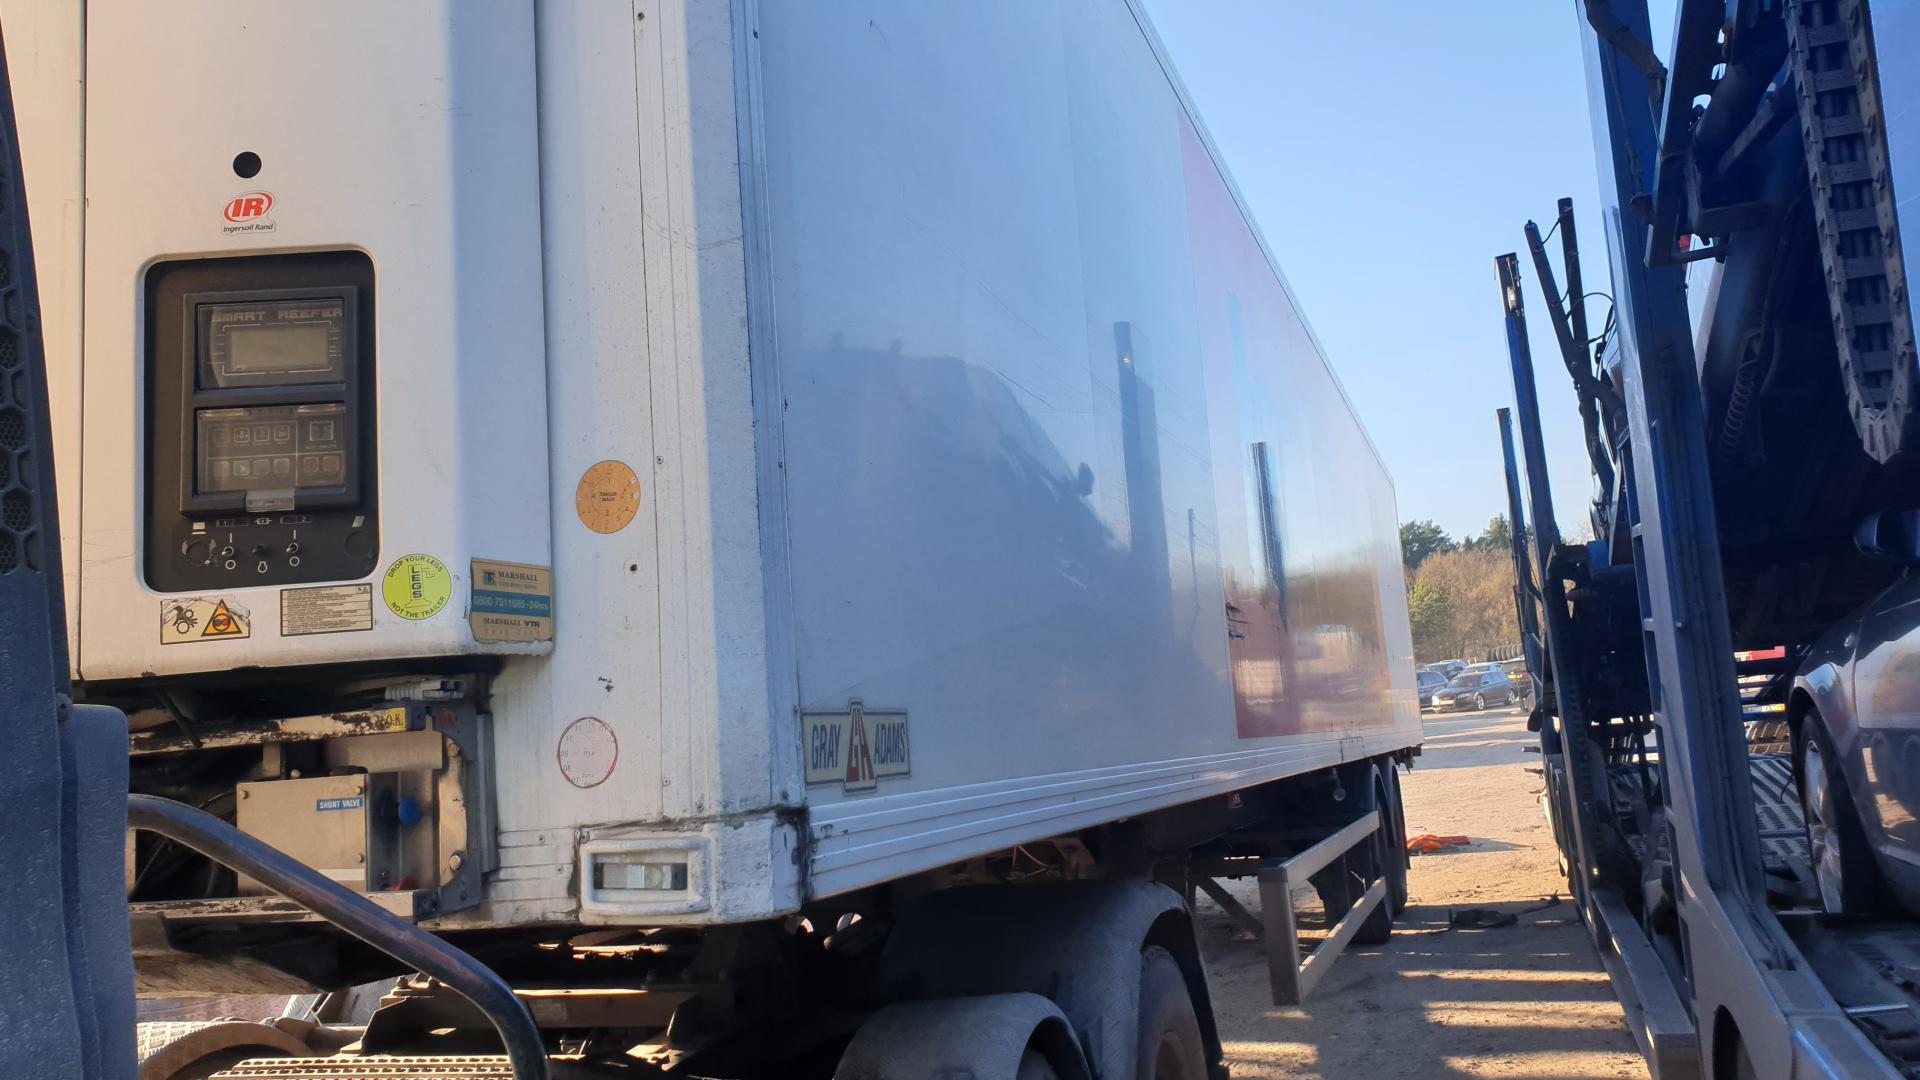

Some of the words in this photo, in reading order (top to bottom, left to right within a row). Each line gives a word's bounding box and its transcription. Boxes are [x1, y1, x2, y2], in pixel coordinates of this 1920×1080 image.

[232, 198, 264, 217] IR
[223, 224, 254, 233] Ingersoll
[255, 223, 274, 231] Rand
[388, 560, 404, 578] DROP
[405, 555, 426, 563] YOUR
[427, 556, 443, 573] LEGS
[498, 570, 538, 582] MARSHALL
[411, 566, 422, 599] LEGS
[391, 602, 405, 613] NOT
[406, 610, 418, 618] THE
[420, 595, 446, 618] TRAILER
[483, 617, 522, 627] MARSHALL
[524, 620, 541, 628] VTR
[812, 724, 841, 770] GRAY
[874, 722, 906, 764] ADAMS
[319, 800, 341, 809] SHUNT
[342, 798, 361, 808] VALVE
